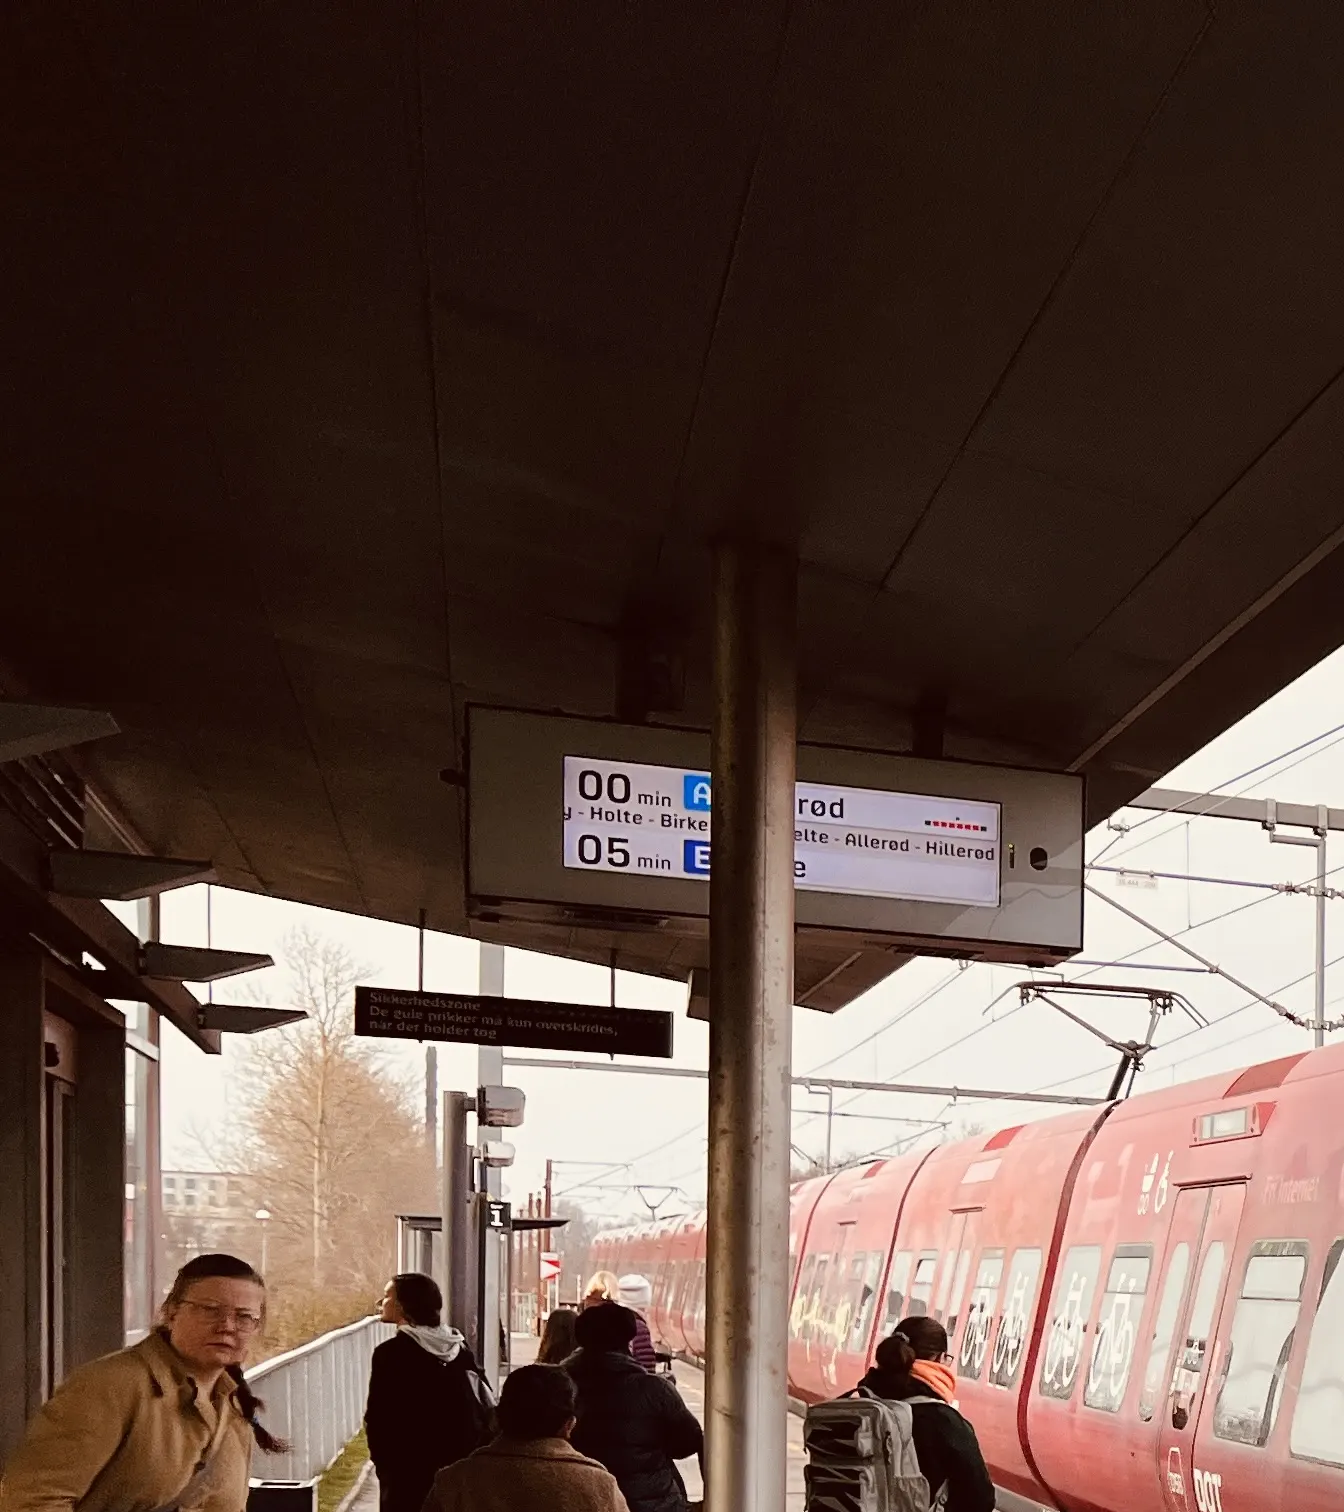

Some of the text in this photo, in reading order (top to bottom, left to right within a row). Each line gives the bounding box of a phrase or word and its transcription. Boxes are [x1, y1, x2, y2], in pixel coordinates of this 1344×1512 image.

[578, 770, 672, 807] 00 min
[693, 782, 711, 805] A
[590, 806, 643, 825] Holte
[660, 813, 708, 832] Birke
[578, 834, 671, 870] 05 min
[694, 845, 711, 869] E
[845, 833, 910, 852] Allerød
[926, 841, 995, 861] Hillerød
[369, 1005, 389, 1017] De
[393, 1009, 423, 1020] gule
[428, 1012, 477, 1024] prikker
[507, 1016, 532, 1028] kun
[396, 1021, 420, 1032] der
[424, 1024, 470, 1036] holder
[472, 1028, 497, 1039] tog
[490, 1210, 504, 1227] 1
